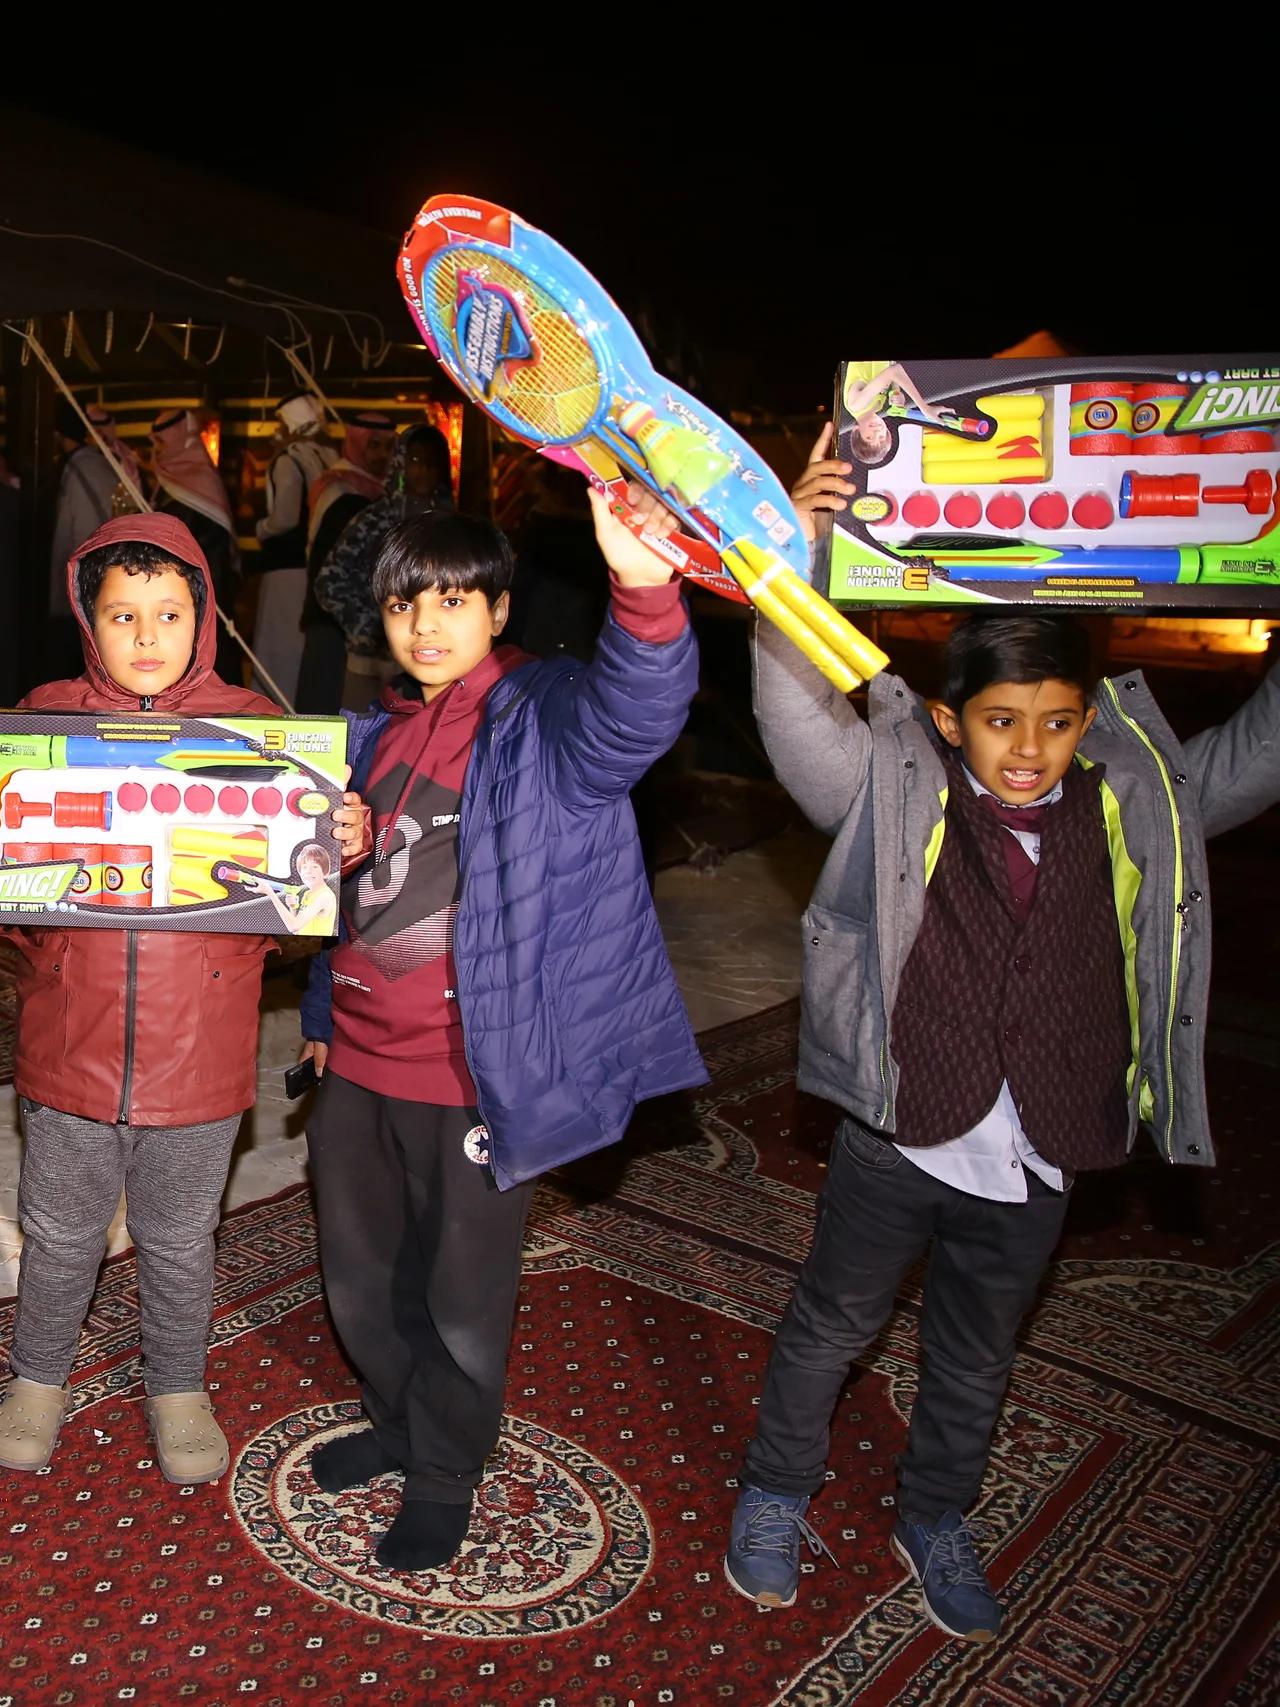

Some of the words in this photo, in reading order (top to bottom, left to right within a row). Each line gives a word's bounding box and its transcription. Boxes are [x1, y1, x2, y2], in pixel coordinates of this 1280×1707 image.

[402, 257, 412, 273] FOR
[405, 274, 418, 298] GOOD
[466, 294, 487, 374] ASSEMBLY
[479, 297, 503, 381] INSTRUCTIONS
[849, 565, 882, 577] ONE!
[886, 565, 901, 577] IN
[902, 567, 929, 591] 3
[847, 576, 900, 588] FUNCTION
[264, 729, 286, 751] 3
[288, 733, 332, 743] FUNCTION
[288, 743, 300, 752] IN
[304, 743, 331, 753] ONE!
[19, 903, 45, 913] DART
